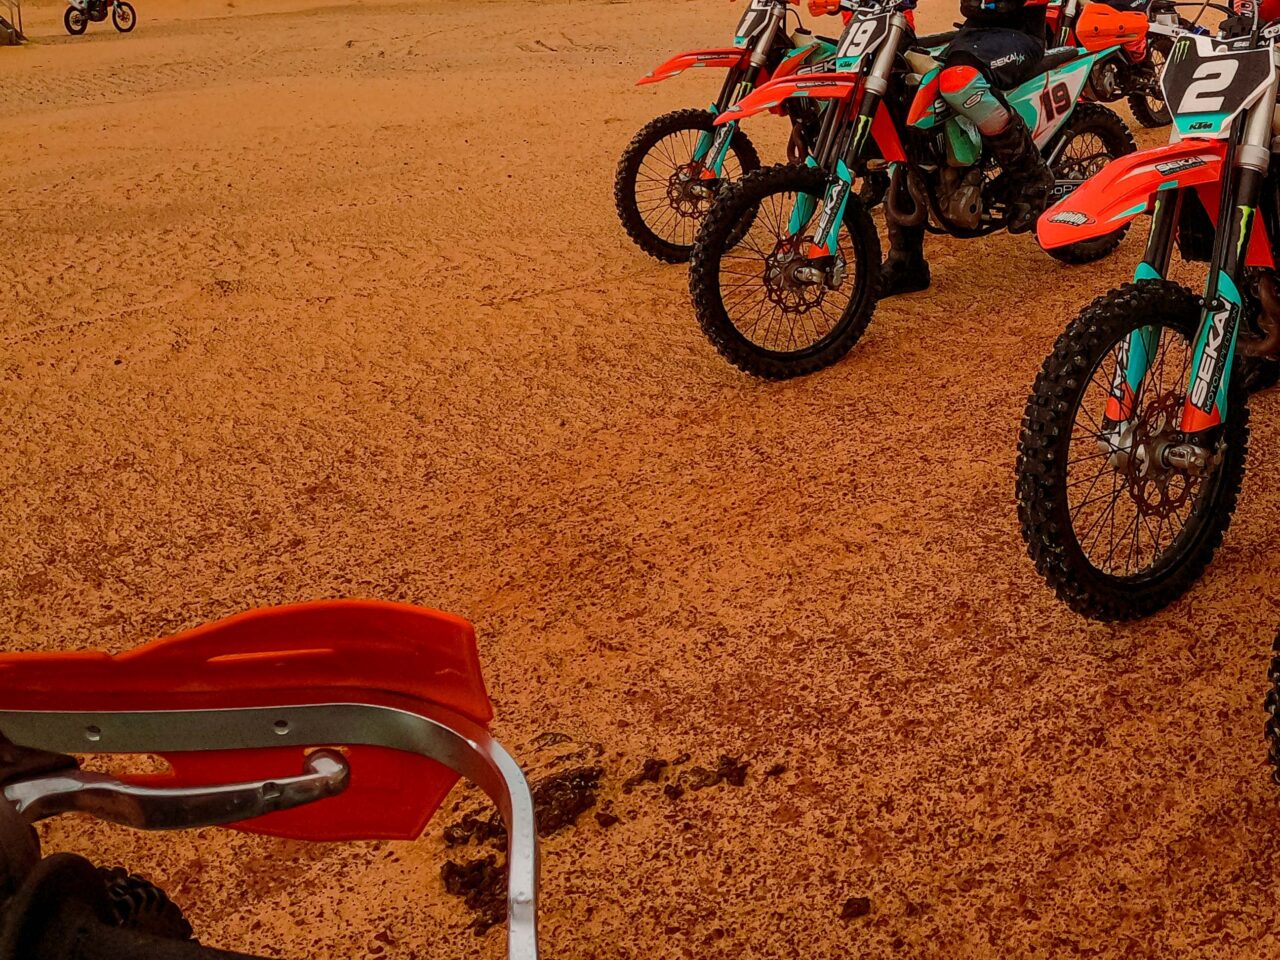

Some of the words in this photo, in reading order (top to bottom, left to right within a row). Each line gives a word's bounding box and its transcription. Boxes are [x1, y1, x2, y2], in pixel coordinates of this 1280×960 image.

[840, 20, 878, 56] 19
[1233, 40, 1270, 48] SEAI
[991, 52, 1017, 68] SEKAI
[1177, 58, 1239, 113] 2
[1039, 81, 1072, 123] 19
[1189, 121, 1214, 131] KTM
[1155, 156, 1202, 172] SEKAI
[1190, 296, 1232, 408] SEKAI
